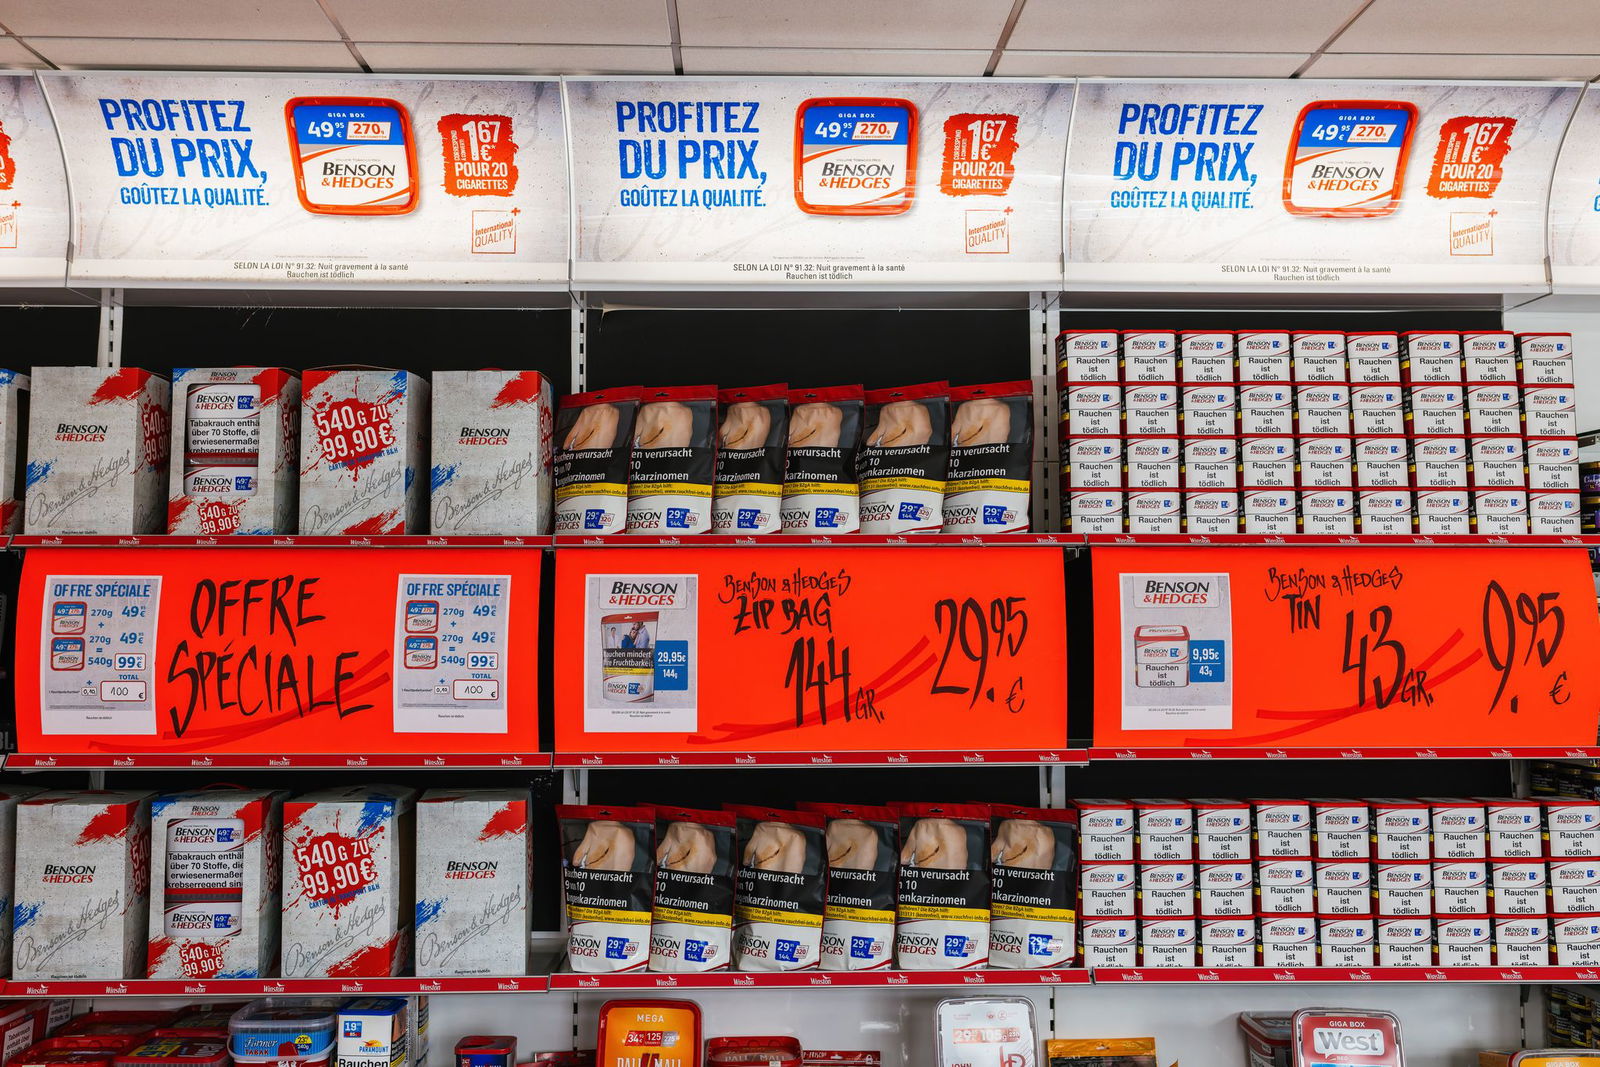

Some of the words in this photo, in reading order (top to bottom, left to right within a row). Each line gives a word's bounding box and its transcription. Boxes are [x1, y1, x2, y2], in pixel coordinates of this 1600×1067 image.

[98, 98, 251, 132] PROFITEZ
[615, 101, 760, 133] PROFITEZ
[1118, 103, 1264, 135] PROFITEZ
[110, 137, 164, 178] DU
[171, 138, 267, 184] PRIX,
[618, 139, 667, 180] DU
[678, 139, 767, 185] PRIX,
[1113, 141, 1163, 181] DU
[1170, 142, 1258, 187] PRIX,
[322, 161, 396, 177] BENSON
[454, 162, 490, 177] POUR
[491, 162, 508, 177] 20
[821, 162, 894, 177] BENSON
[952, 161, 986, 177] POUR
[988, 161, 1005, 177] 20
[1311, 165, 1384, 179] BENSON
[1440, 164, 1476, 179] POUR
[1477, 164, 1494, 179] 20
[456, 179, 508, 190] CIGARETTES
[952, 179, 1003, 190] CIGARETTES
[1438, 181, 1490, 192] CIGARETTES
[120, 182, 180, 206] GOÛTEZ
[183, 187, 201, 206] LA
[204, 184, 270, 209] QUALITÉ.
[620, 184, 678, 207] GOÛTEZ
[681, 189, 700, 207] LA
[702, 185, 766, 210] QUALITÉ.
[1110, 186, 1168, 208] GOÛTEZ
[1171, 191, 1189, 208] LA
[1191, 187, 1254, 212] QUALITÉ.
[475, 218, 514, 236] International
[968, 218, 1007, 236] International
[1452, 220, 1491, 238] International
[474, 228, 514, 248] QUALITY
[968, 228, 1007, 248] QUALITY
[1452, 230, 1490, 250] QUALITY
[733, 263, 758, 272] SELON
[759, 263, 769, 272] LA
[770, 263, 782, 272] LOI
[783, 263, 794, 272] N°
[816, 263, 831, 272] Nuit
[832, 264, 870, 273] gravement
[871, 263, 876, 272] à
[877, 263, 885, 272] la
[885, 263, 906, 272] santé
[286, 270, 319, 279] Rauchen
[319, 270, 329, 279] ist
[329, 270, 355, 279] tödlich
[785, 272, 817, 280] Rauchen
[818, 272, 828, 280] ist
[828, 272, 853, 280] tödlich
[1273, 273, 1305, 282] Rauchen
[1305, 273, 1315, 282] ist
[1316, 273, 1340, 282] tödlich
[1076, 357, 1110, 365] Rauchen
[1532, 359, 1566, 367] Rauchen
[1088, 365, 1098, 373] ist
[1544, 367, 1554, 375] ist
[1080, 373, 1107, 381] tödlich
[1536, 375, 1563, 383] tödlich
[371, 403, 388, 422] ZU
[56, 424, 108, 433] BENSON
[190, 419, 235, 428] Tabakrauch
[192, 428, 210, 437] über
[211, 428, 221, 436] 70
[222, 428, 249, 438] Stoffe,
[645, 448, 693, 460] verursacht
[963, 444, 1010, 456] verursacht
[54, 583, 92, 598] OFFRE
[95, 580, 151, 598] SPÉCIALE
[406, 583, 444, 597] OFFRE
[446, 580, 500, 597] SPÉCIALE
[611, 581, 678, 595] BENSON
[1145, 580, 1210, 594] BENSON
[90, 608, 113, 619] 270g
[191, 574, 326, 647] OFFRE
[733, 593, 774, 636] ZIP
[780, 592, 832, 635] BAG
[1281, 593, 1321, 634] TIN
[89, 635, 111, 645] 270g
[626, 650, 651, 658] mindert
[1342, 605, 1406, 709] 43
[1401, 668, 1434, 708] GR.
[87, 656, 113, 668] 540g
[440, 655, 466, 667] 540g
[471, 672, 492, 680] TOTAL
[784, 636, 851, 729] 144
[855, 686, 886, 725] GR.
[1149, 679, 1175, 687] tödlich
[1549, 671, 1571, 705] €
[110, 686, 129, 697] 100
[167, 639, 375, 739] SPÉCIALE
[1004, 676, 1026, 714] €
[581, 757, 603, 765] Winston
[1443, 833, 1478, 841] Rauchen
[1456, 841, 1466, 849] ist
[1448, 849, 1475, 858] tödlich
[44, 864, 96, 875] BENSON
[446, 861, 498, 871] BENSON
[589, 872, 633, 883] verursacht
[921, 870, 970, 881] verursacht
[1350, 972, 1371, 980] Winston
[656, 978, 677, 987] Winston
[26, 985, 48, 994] Winston
[636, 1013, 665, 1023] MEGA
[1329, 1020, 1348, 1028] GIGA
[1349, 1020, 1366, 1028] BOX
[646, 1032, 661, 1041] 125
[1318, 1031, 1378, 1051] West
[359, 1045, 388, 1053] PARAMOUNT
[339, 1058, 388, 1067] Rauchen
